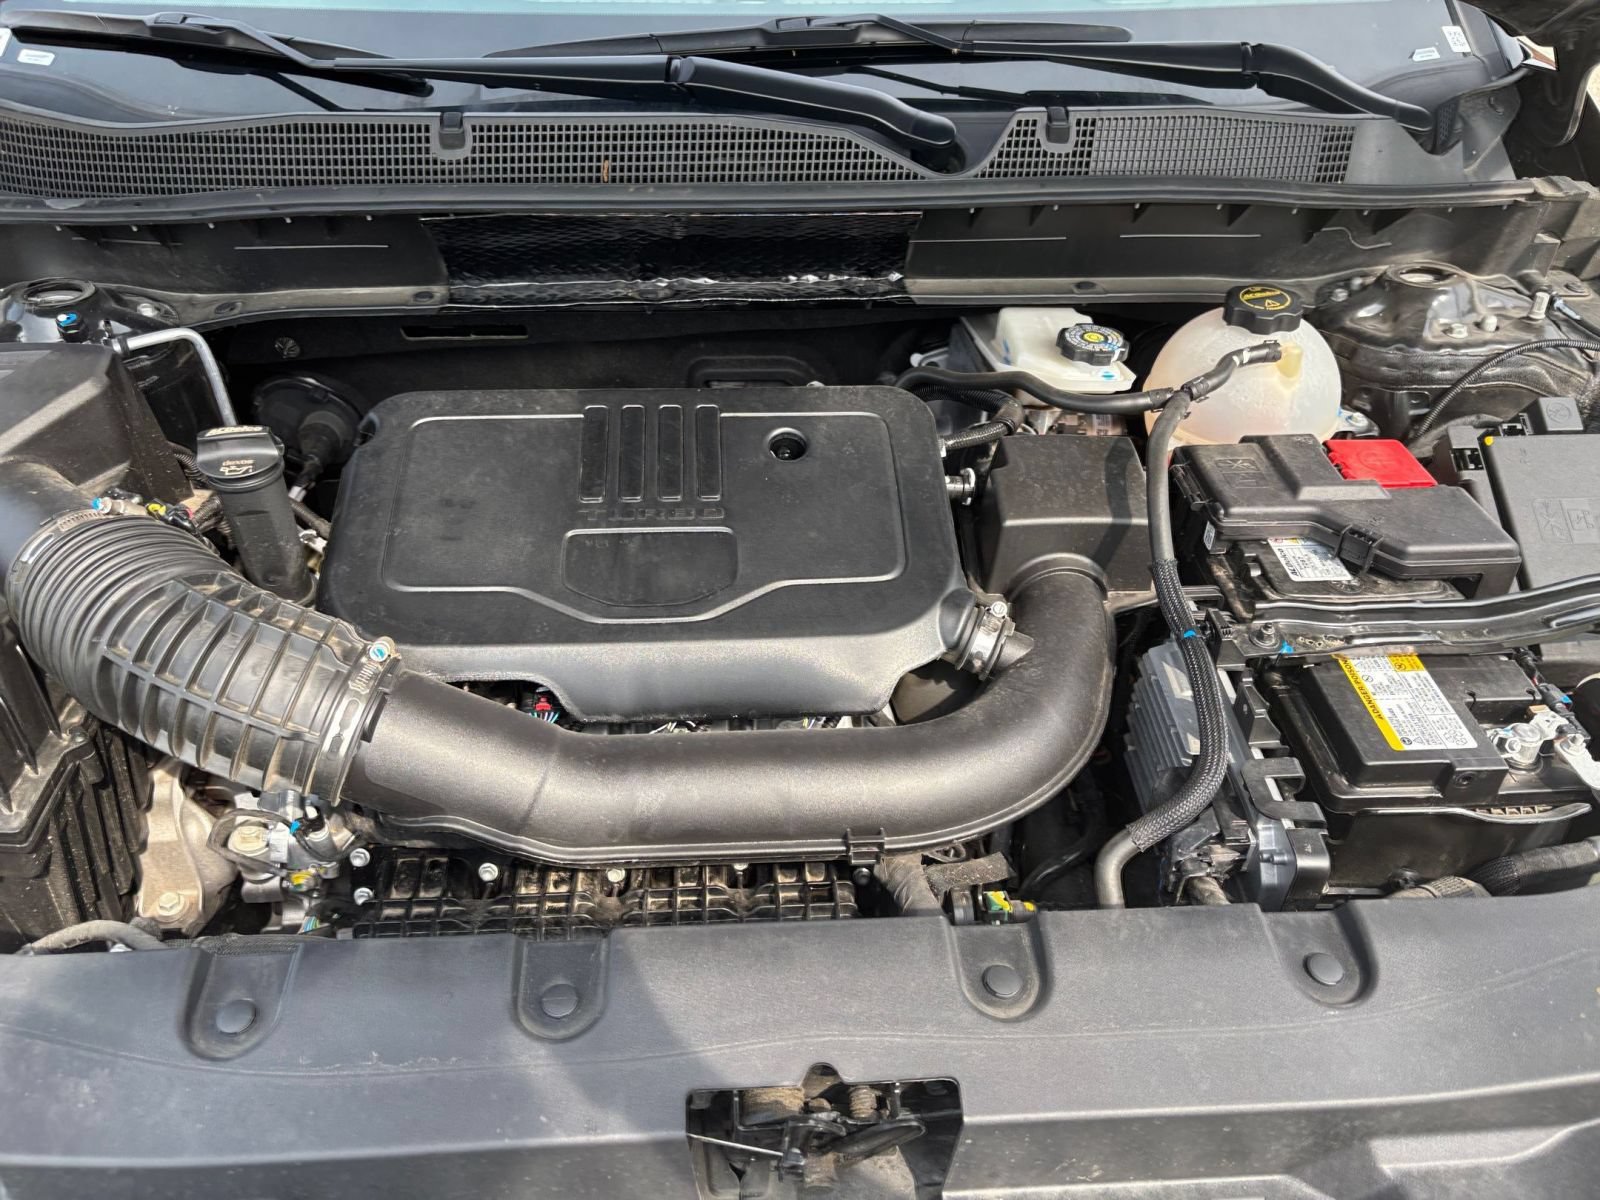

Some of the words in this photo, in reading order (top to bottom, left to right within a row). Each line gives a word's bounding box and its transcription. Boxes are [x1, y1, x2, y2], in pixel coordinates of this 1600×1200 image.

[205, 425, 263, 436] ACDelco
[578, 508, 725, 521] TURBO
[1342, 659, 1361, 685] POISON
[1358, 686, 1380, 714] DANGER
